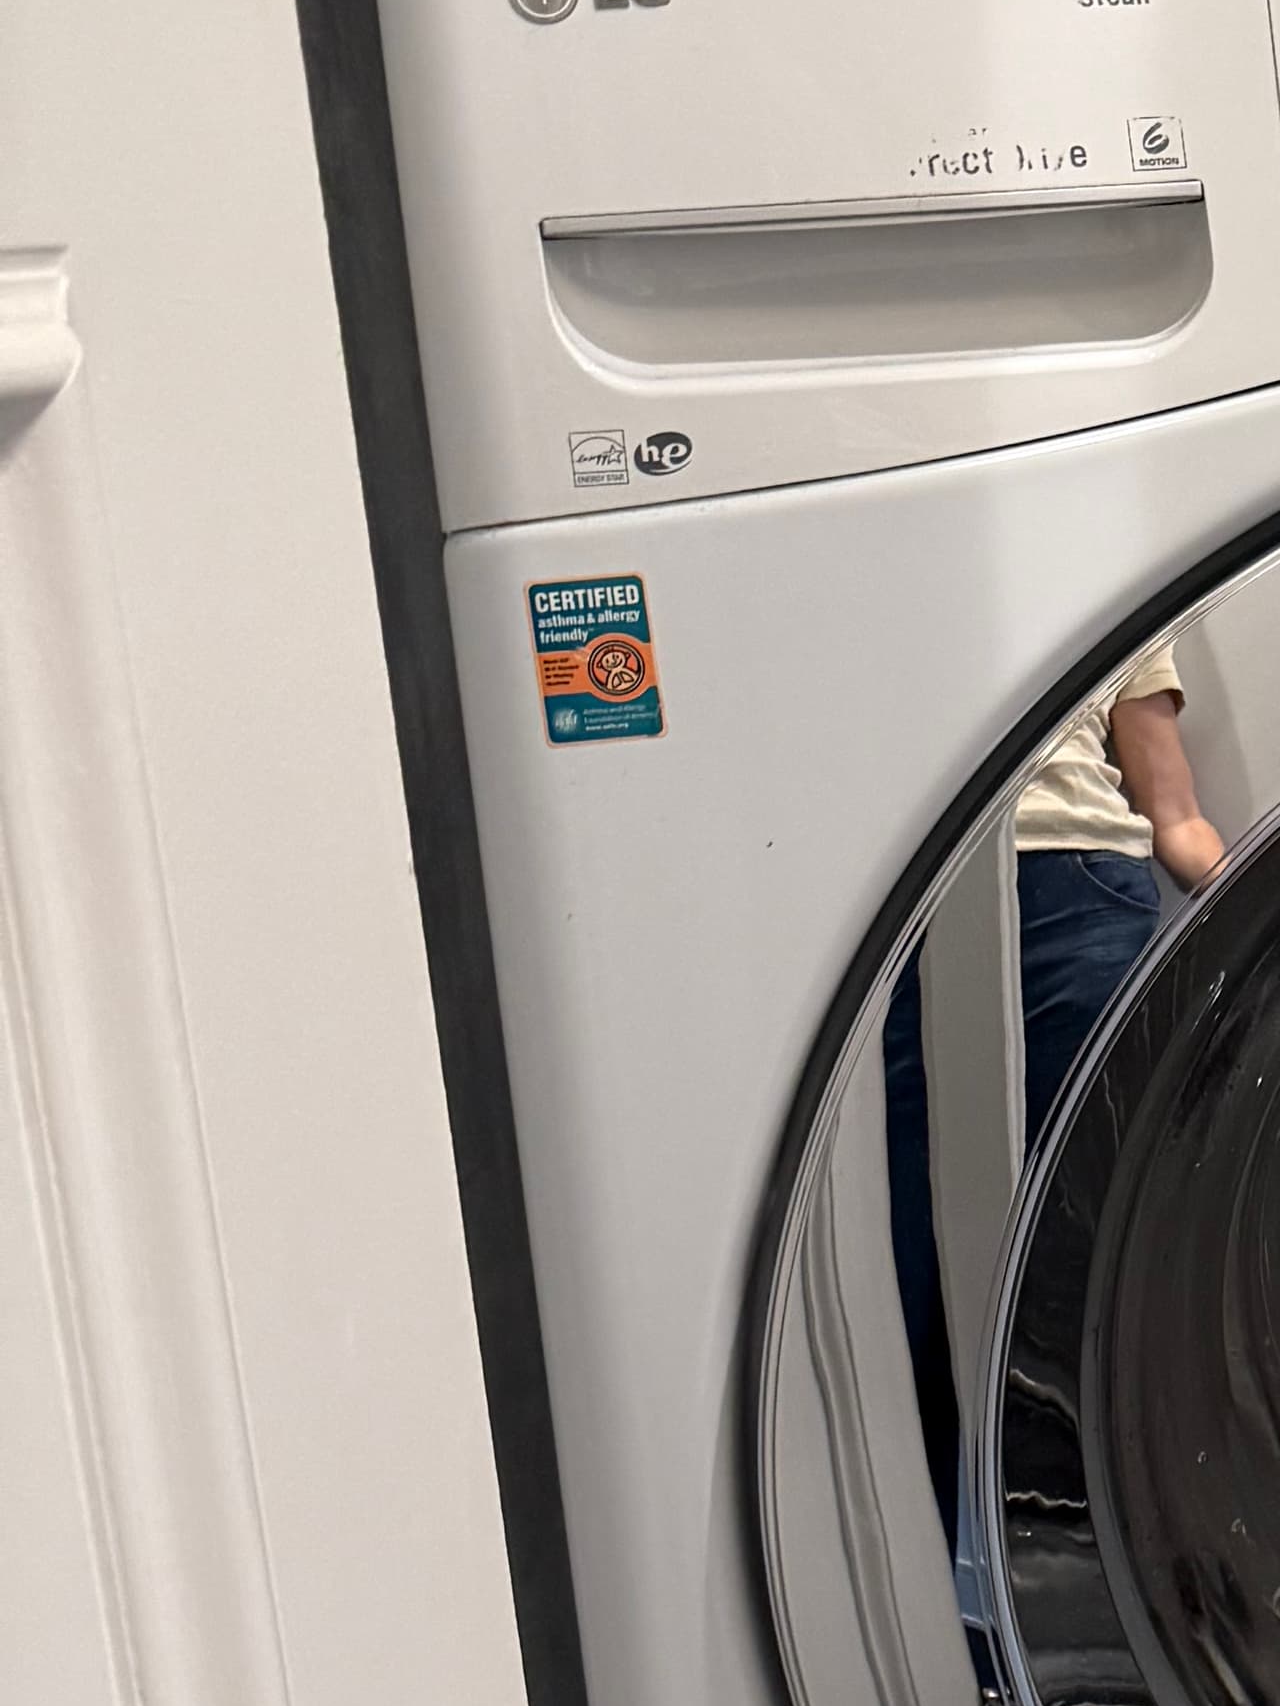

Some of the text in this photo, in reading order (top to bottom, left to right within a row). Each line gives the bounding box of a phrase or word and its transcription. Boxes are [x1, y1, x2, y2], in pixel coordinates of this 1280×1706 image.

[1139, 156, 1180, 167] MOTION
[534, 584, 640, 613] CERTIFIED
[538, 609, 640, 629] asthma & allergy
